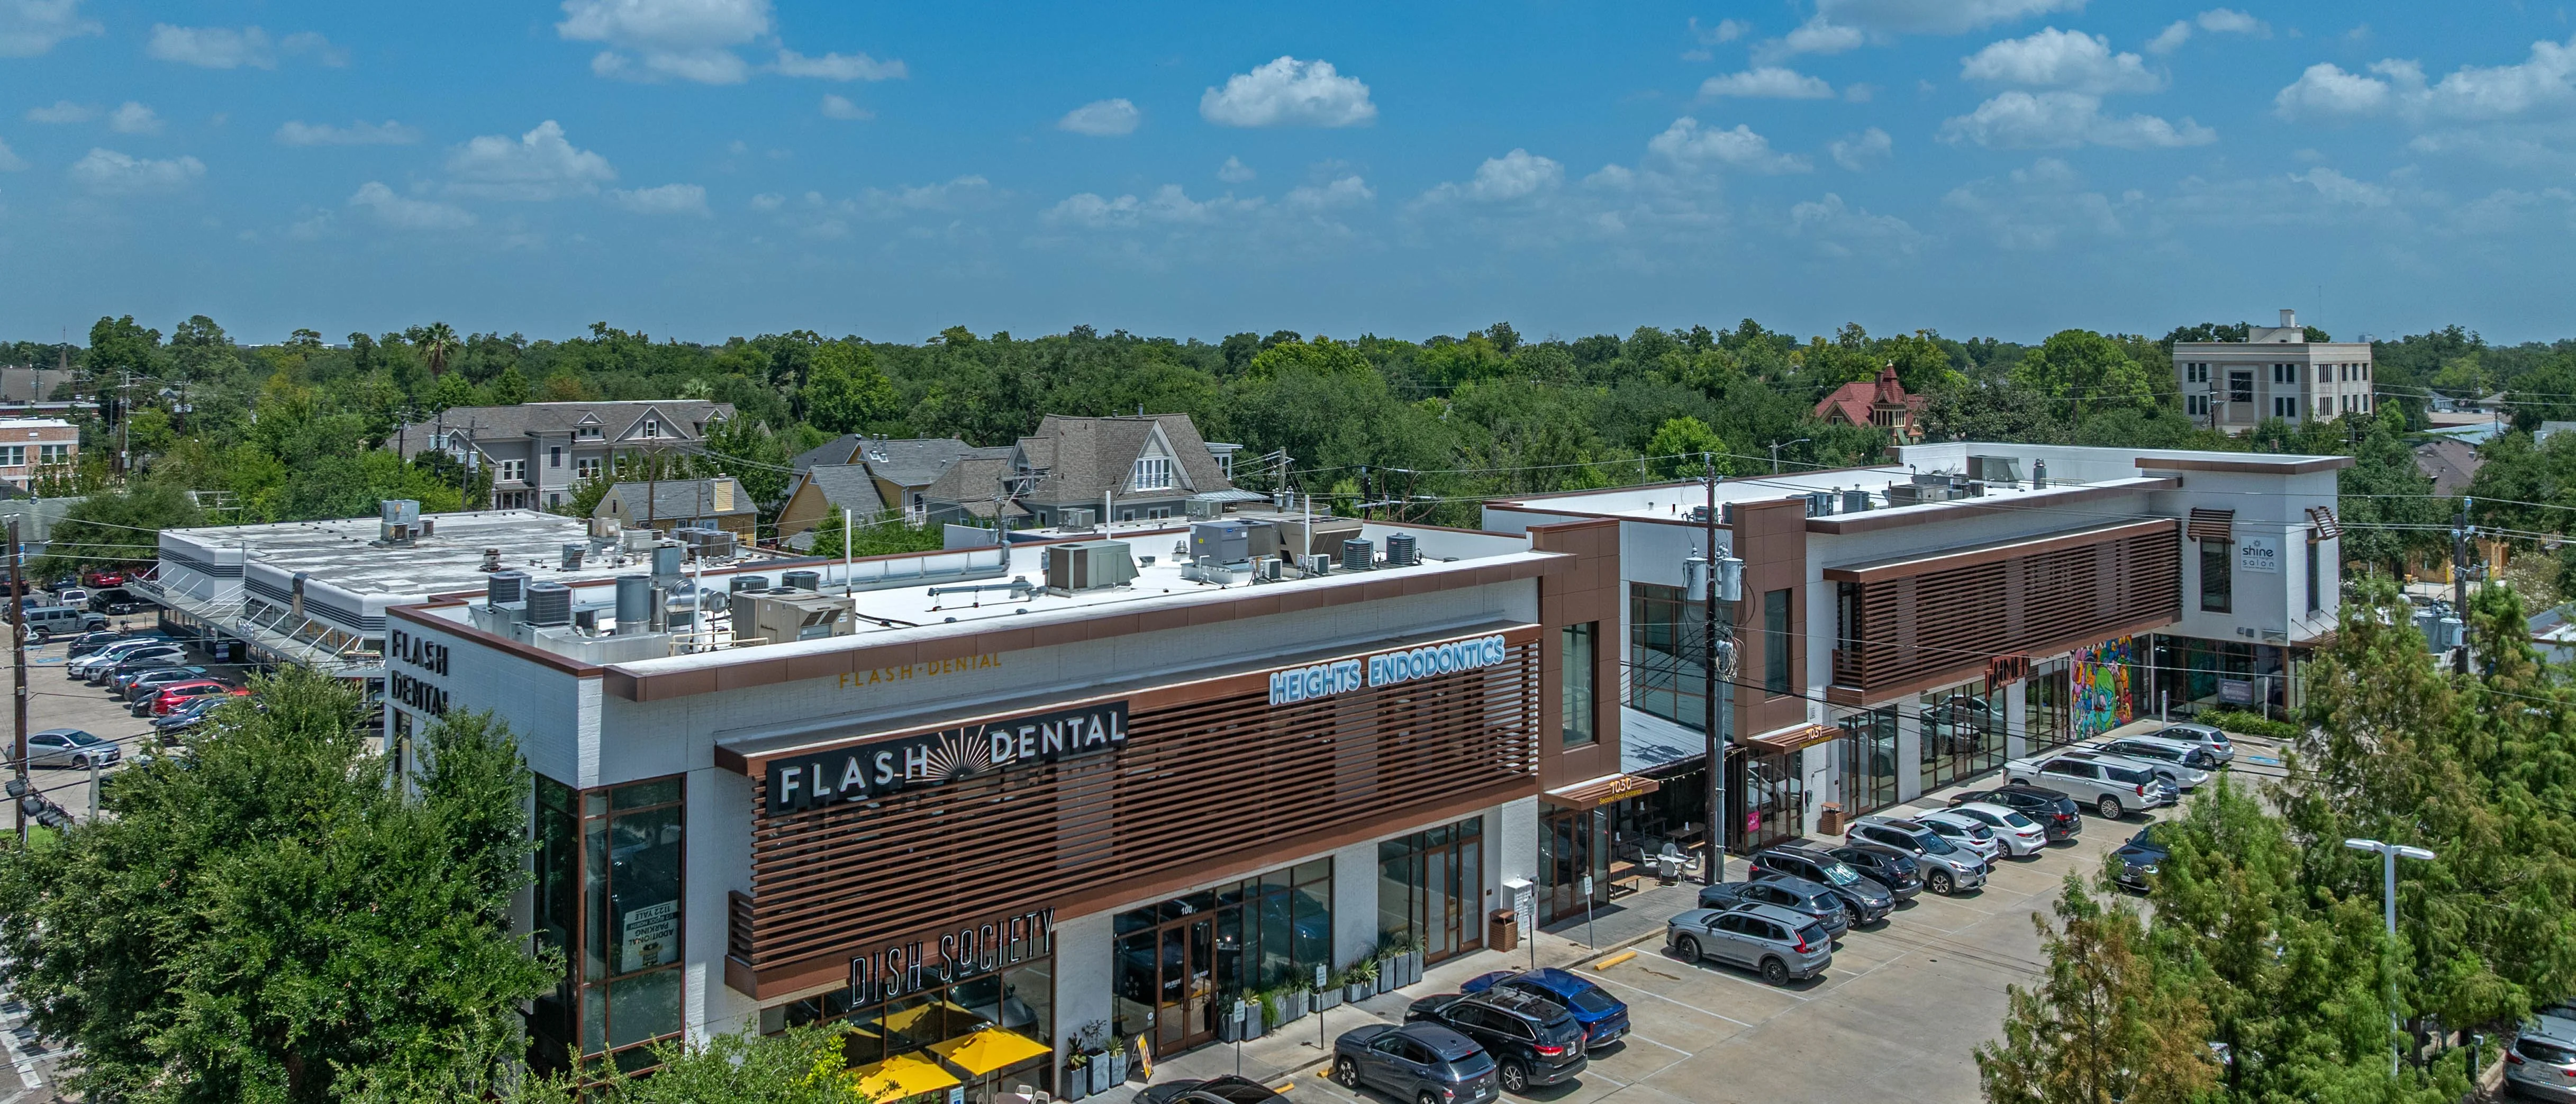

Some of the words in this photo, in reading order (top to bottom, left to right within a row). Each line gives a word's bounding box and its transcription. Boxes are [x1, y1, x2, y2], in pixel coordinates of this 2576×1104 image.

[2243, 545, 2273, 557] shine
[392, 629, 448, 676] FLASH
[840, 664, 912, 689] FLASH
[929, 653, 1002, 676] DENTAL
[1270, 659, 1361, 704] HEIGHTS
[1369, 635, 1505, 687] ENDODONTICS
[1806, 726, 1822, 739] 1051
[780, 744, 928, 803] FLASH
[991, 711, 1126, 764] DENTAL
[1609, 777, 1631, 793] 1050
[1599, 795, 1614, 804] Second
[635, 910, 652, 920] YALE
[655, 905, 670, 915] 1122
[1181, 905, 1192, 915] 100
[629, 928, 674, 946] ADDITIONAL
[635, 922, 669, 937] PARKING
[851, 940, 923, 1007] DISH
[940, 907, 1056, 982] SOCIETY
